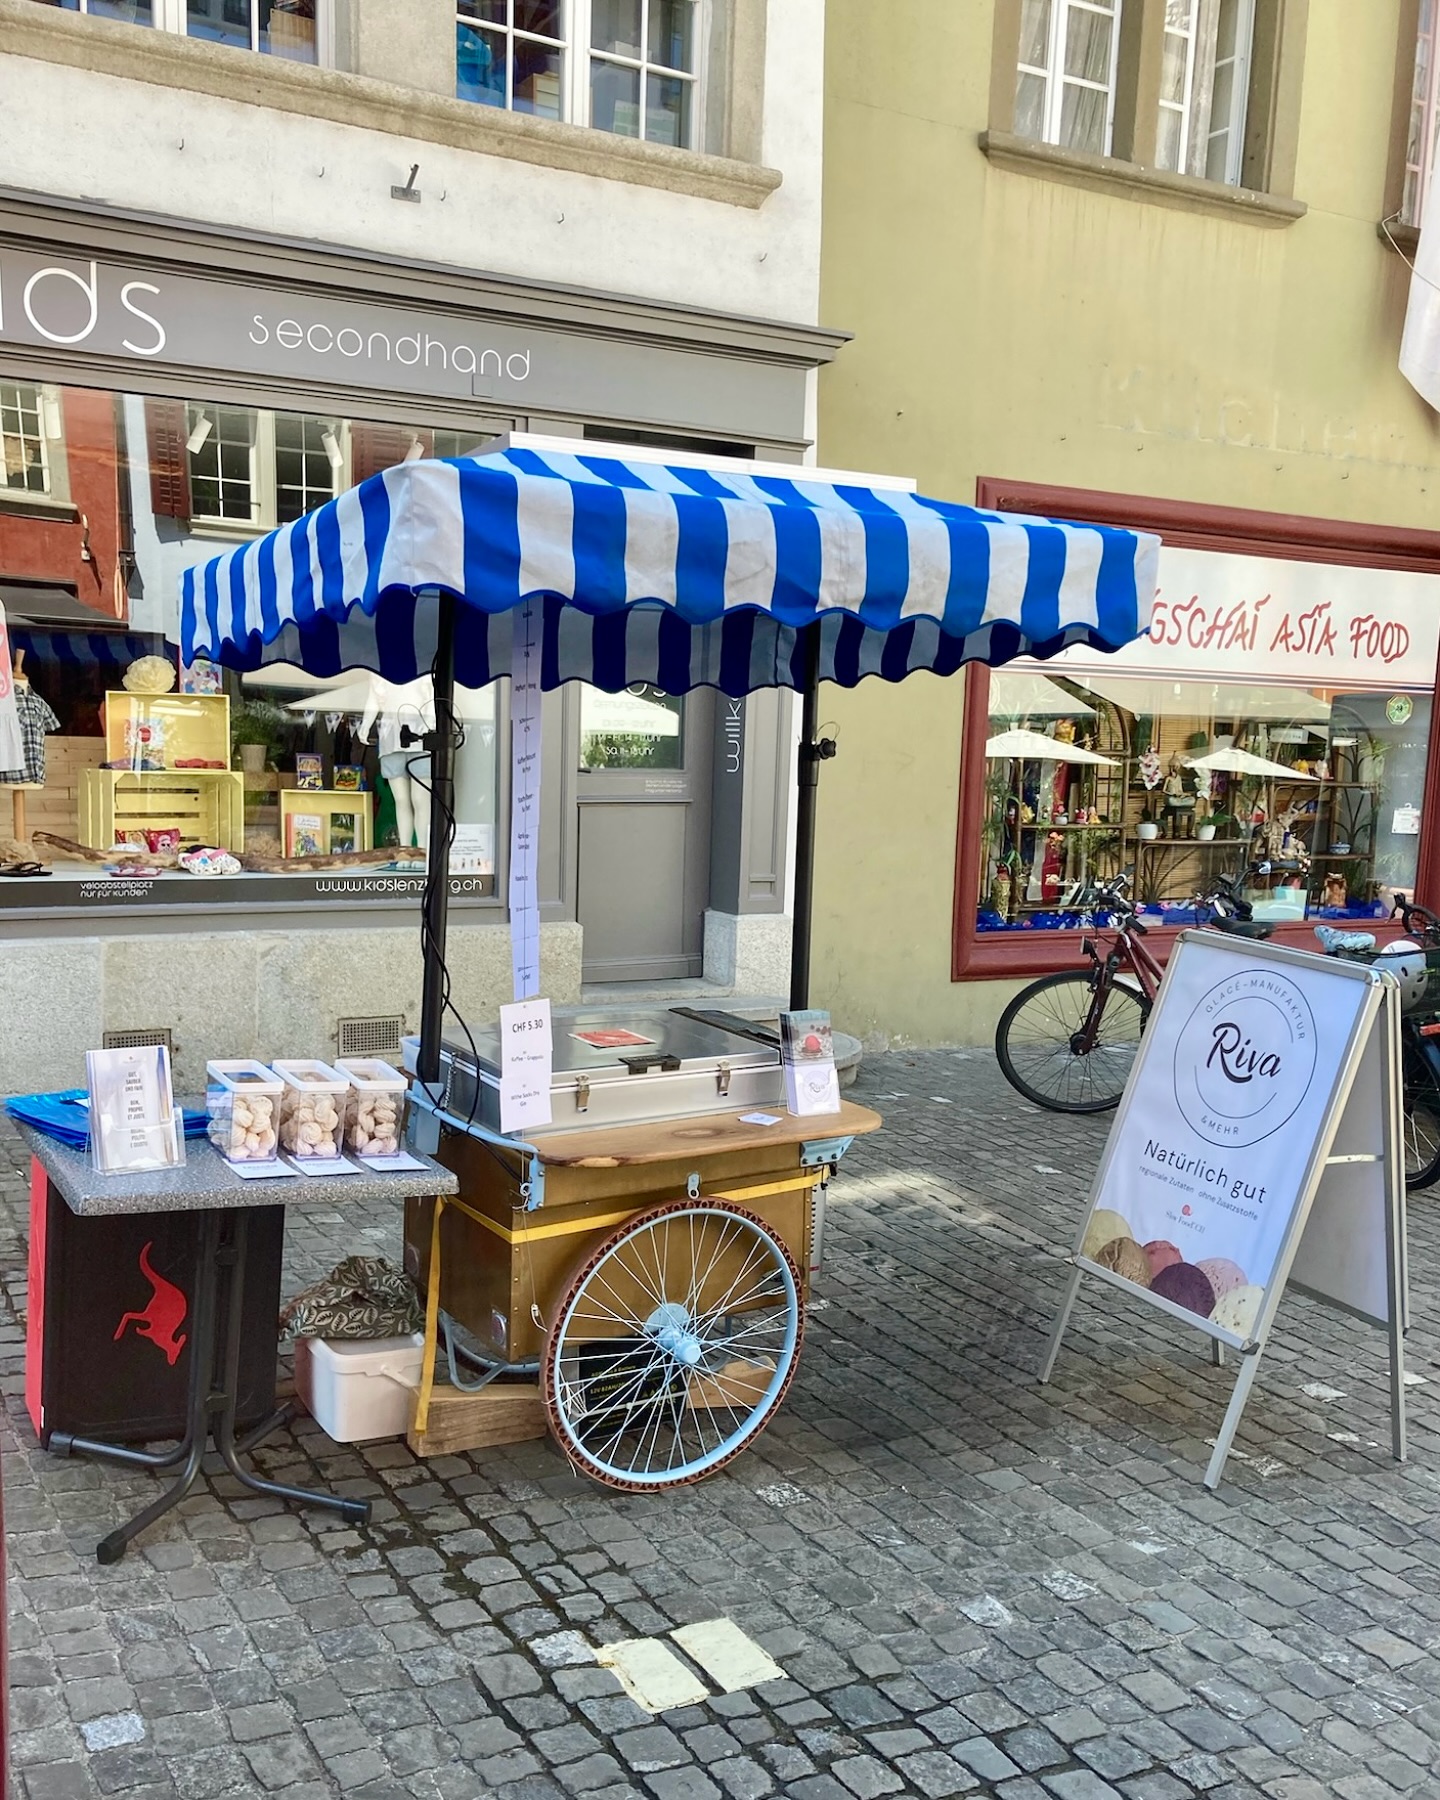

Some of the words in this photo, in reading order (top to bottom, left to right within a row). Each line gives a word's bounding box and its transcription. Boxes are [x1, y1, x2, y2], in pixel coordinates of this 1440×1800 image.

[249, 315, 530, 381] secondhand
[1270, 601, 1337, 656] ASIA
[1350, 614, 1409, 663] FOOD
[80, 890, 96, 898] nur
[315, 878, 482, 893] www.kidslenzg.ch
[512, 1021, 526, 1033] CHF
[528, 1019, 543, 1031] 5.30
[1206, 1022, 1281, 1084] Riva
[1139, 1165, 1168, 1182] regionale
[1169, 1177, 1195, 1193] Zutaten
[1198, 1191, 1216, 1202] ohne
[1144, 1139, 1228, 1188] Natürlich
[1230, 1180, 1267, 1204] gut
